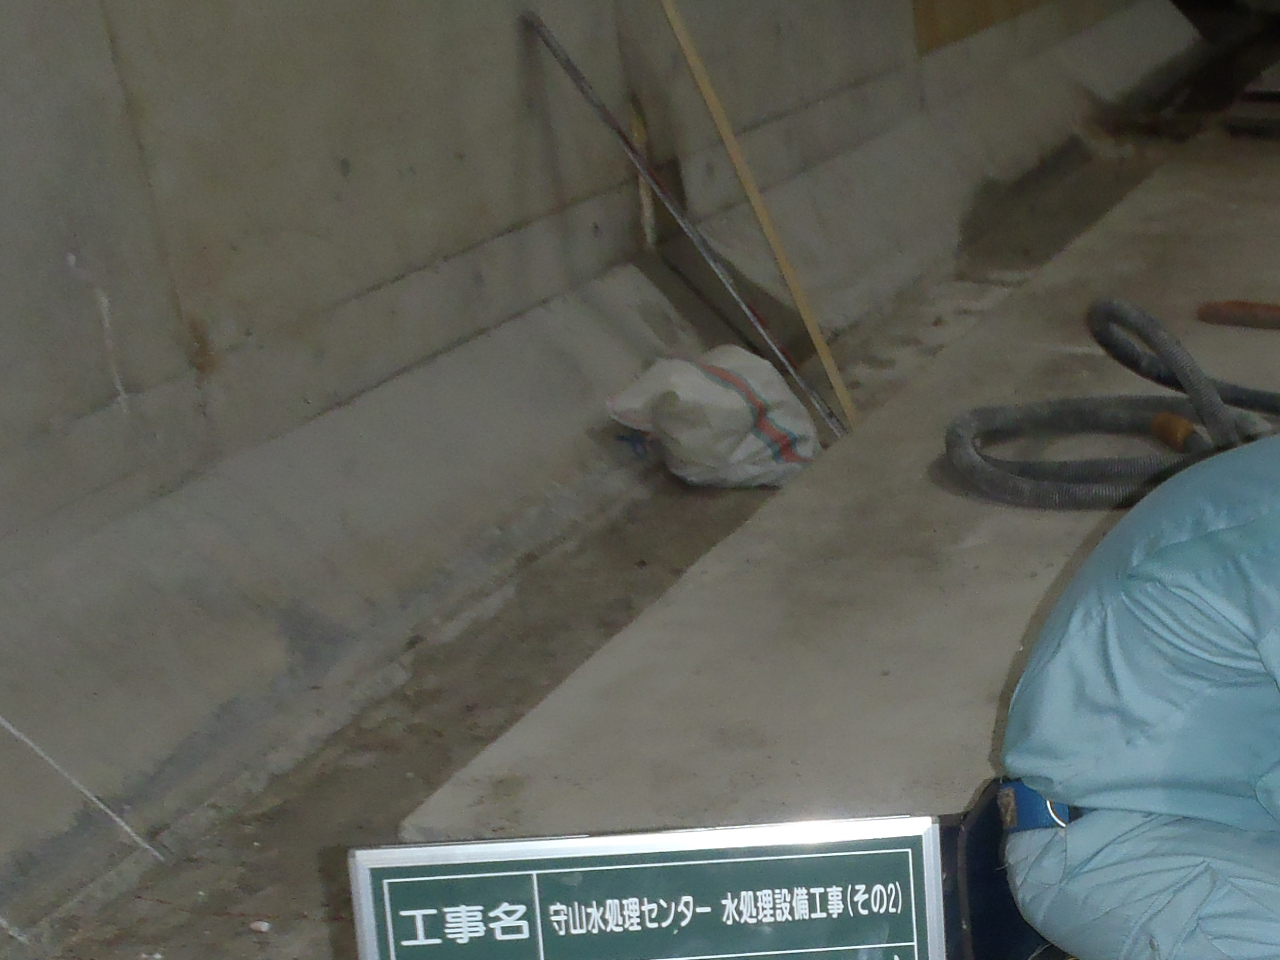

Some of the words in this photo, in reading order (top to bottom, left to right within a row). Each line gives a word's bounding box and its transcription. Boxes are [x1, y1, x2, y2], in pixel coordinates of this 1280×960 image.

[400, 902, 532, 948] 工事名
[549, 895, 712, 936] 守山水処理センター
